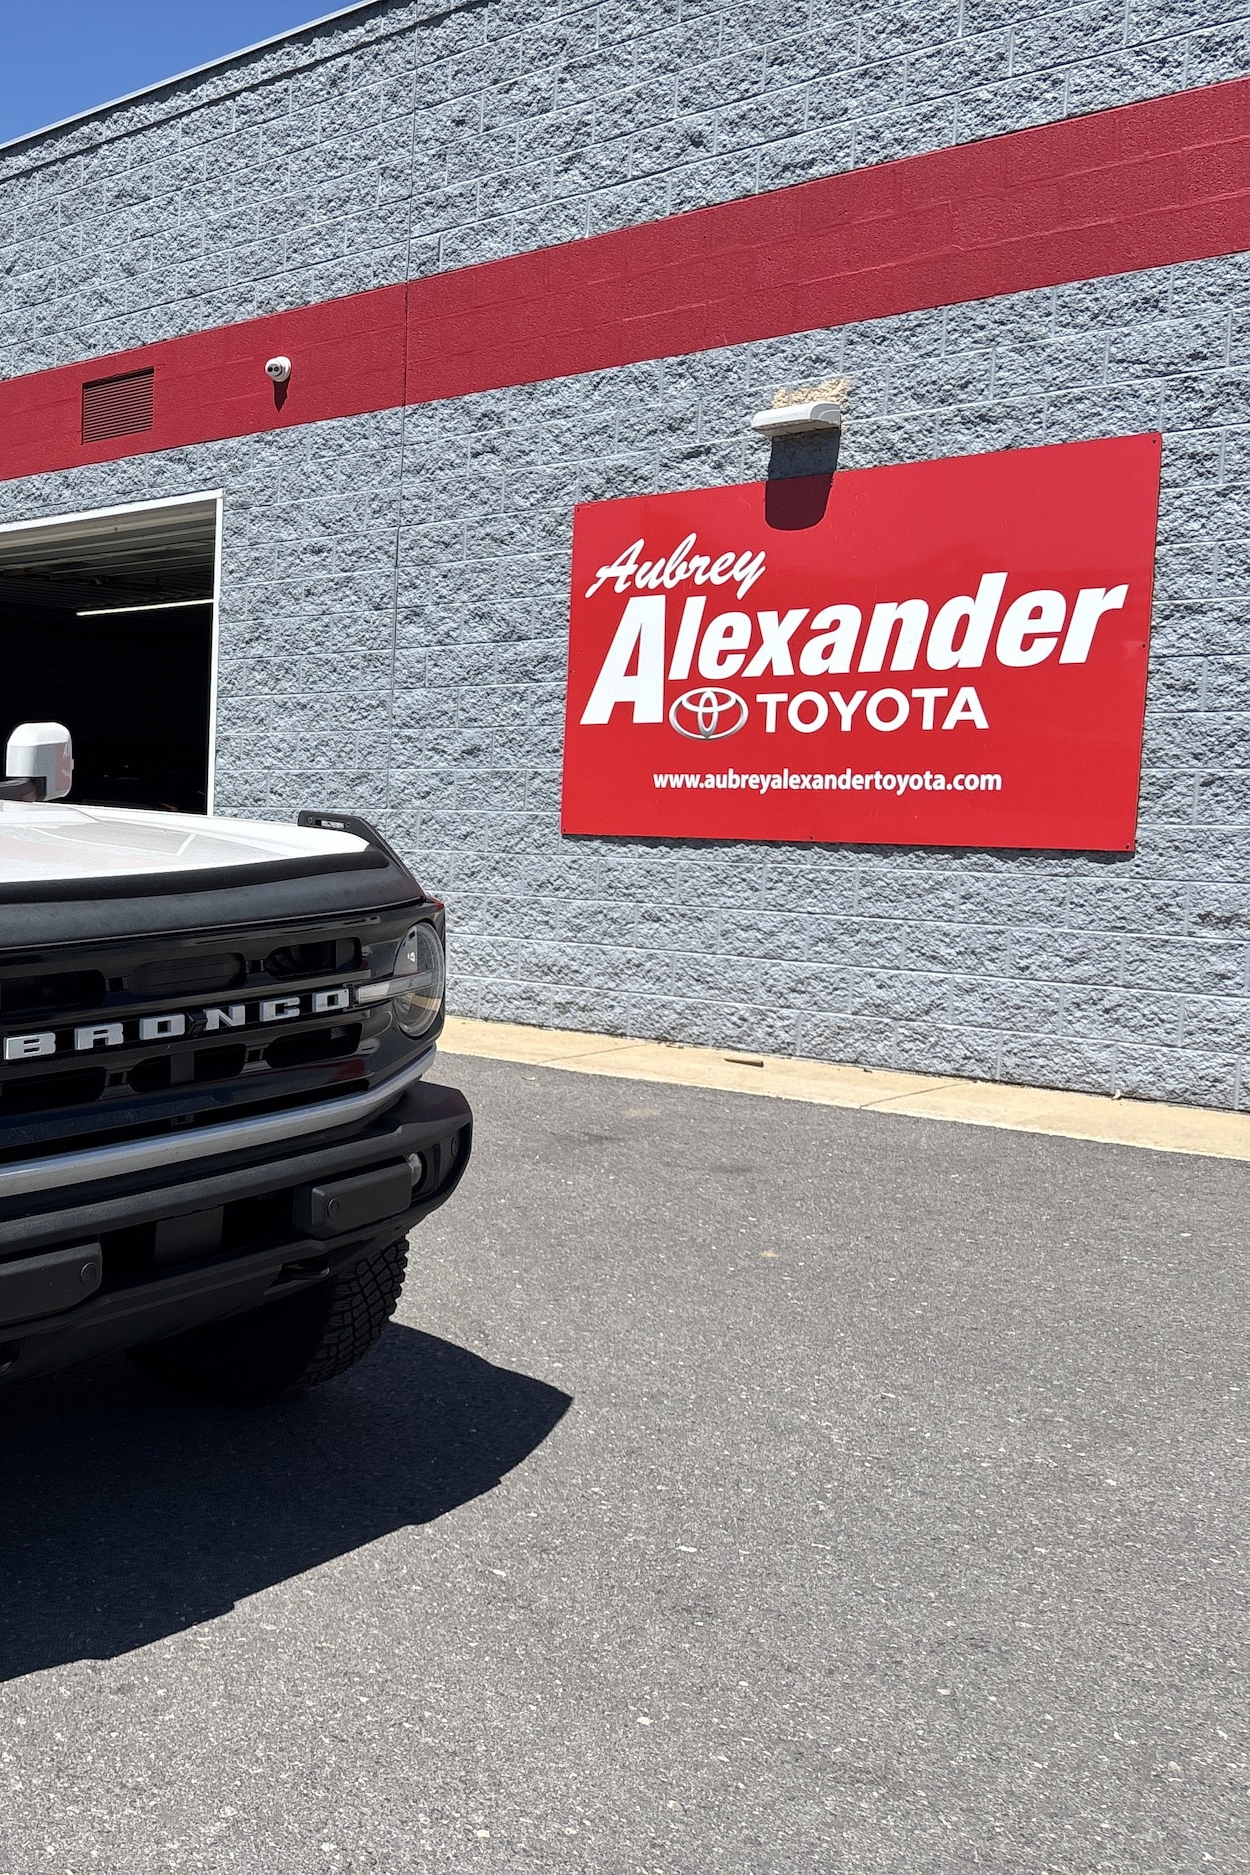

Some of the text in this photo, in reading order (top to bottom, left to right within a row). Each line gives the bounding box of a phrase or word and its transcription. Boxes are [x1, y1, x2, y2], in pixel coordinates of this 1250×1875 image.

[584, 532, 766, 600] Aubrey
[579, 571, 1129, 725] Alexander
[755, 686, 990, 734] TOYOTA
[653, 767, 1002, 796] www.aubreyalexandertoyota.com
[3, 987, 350, 1061] BRONCO
